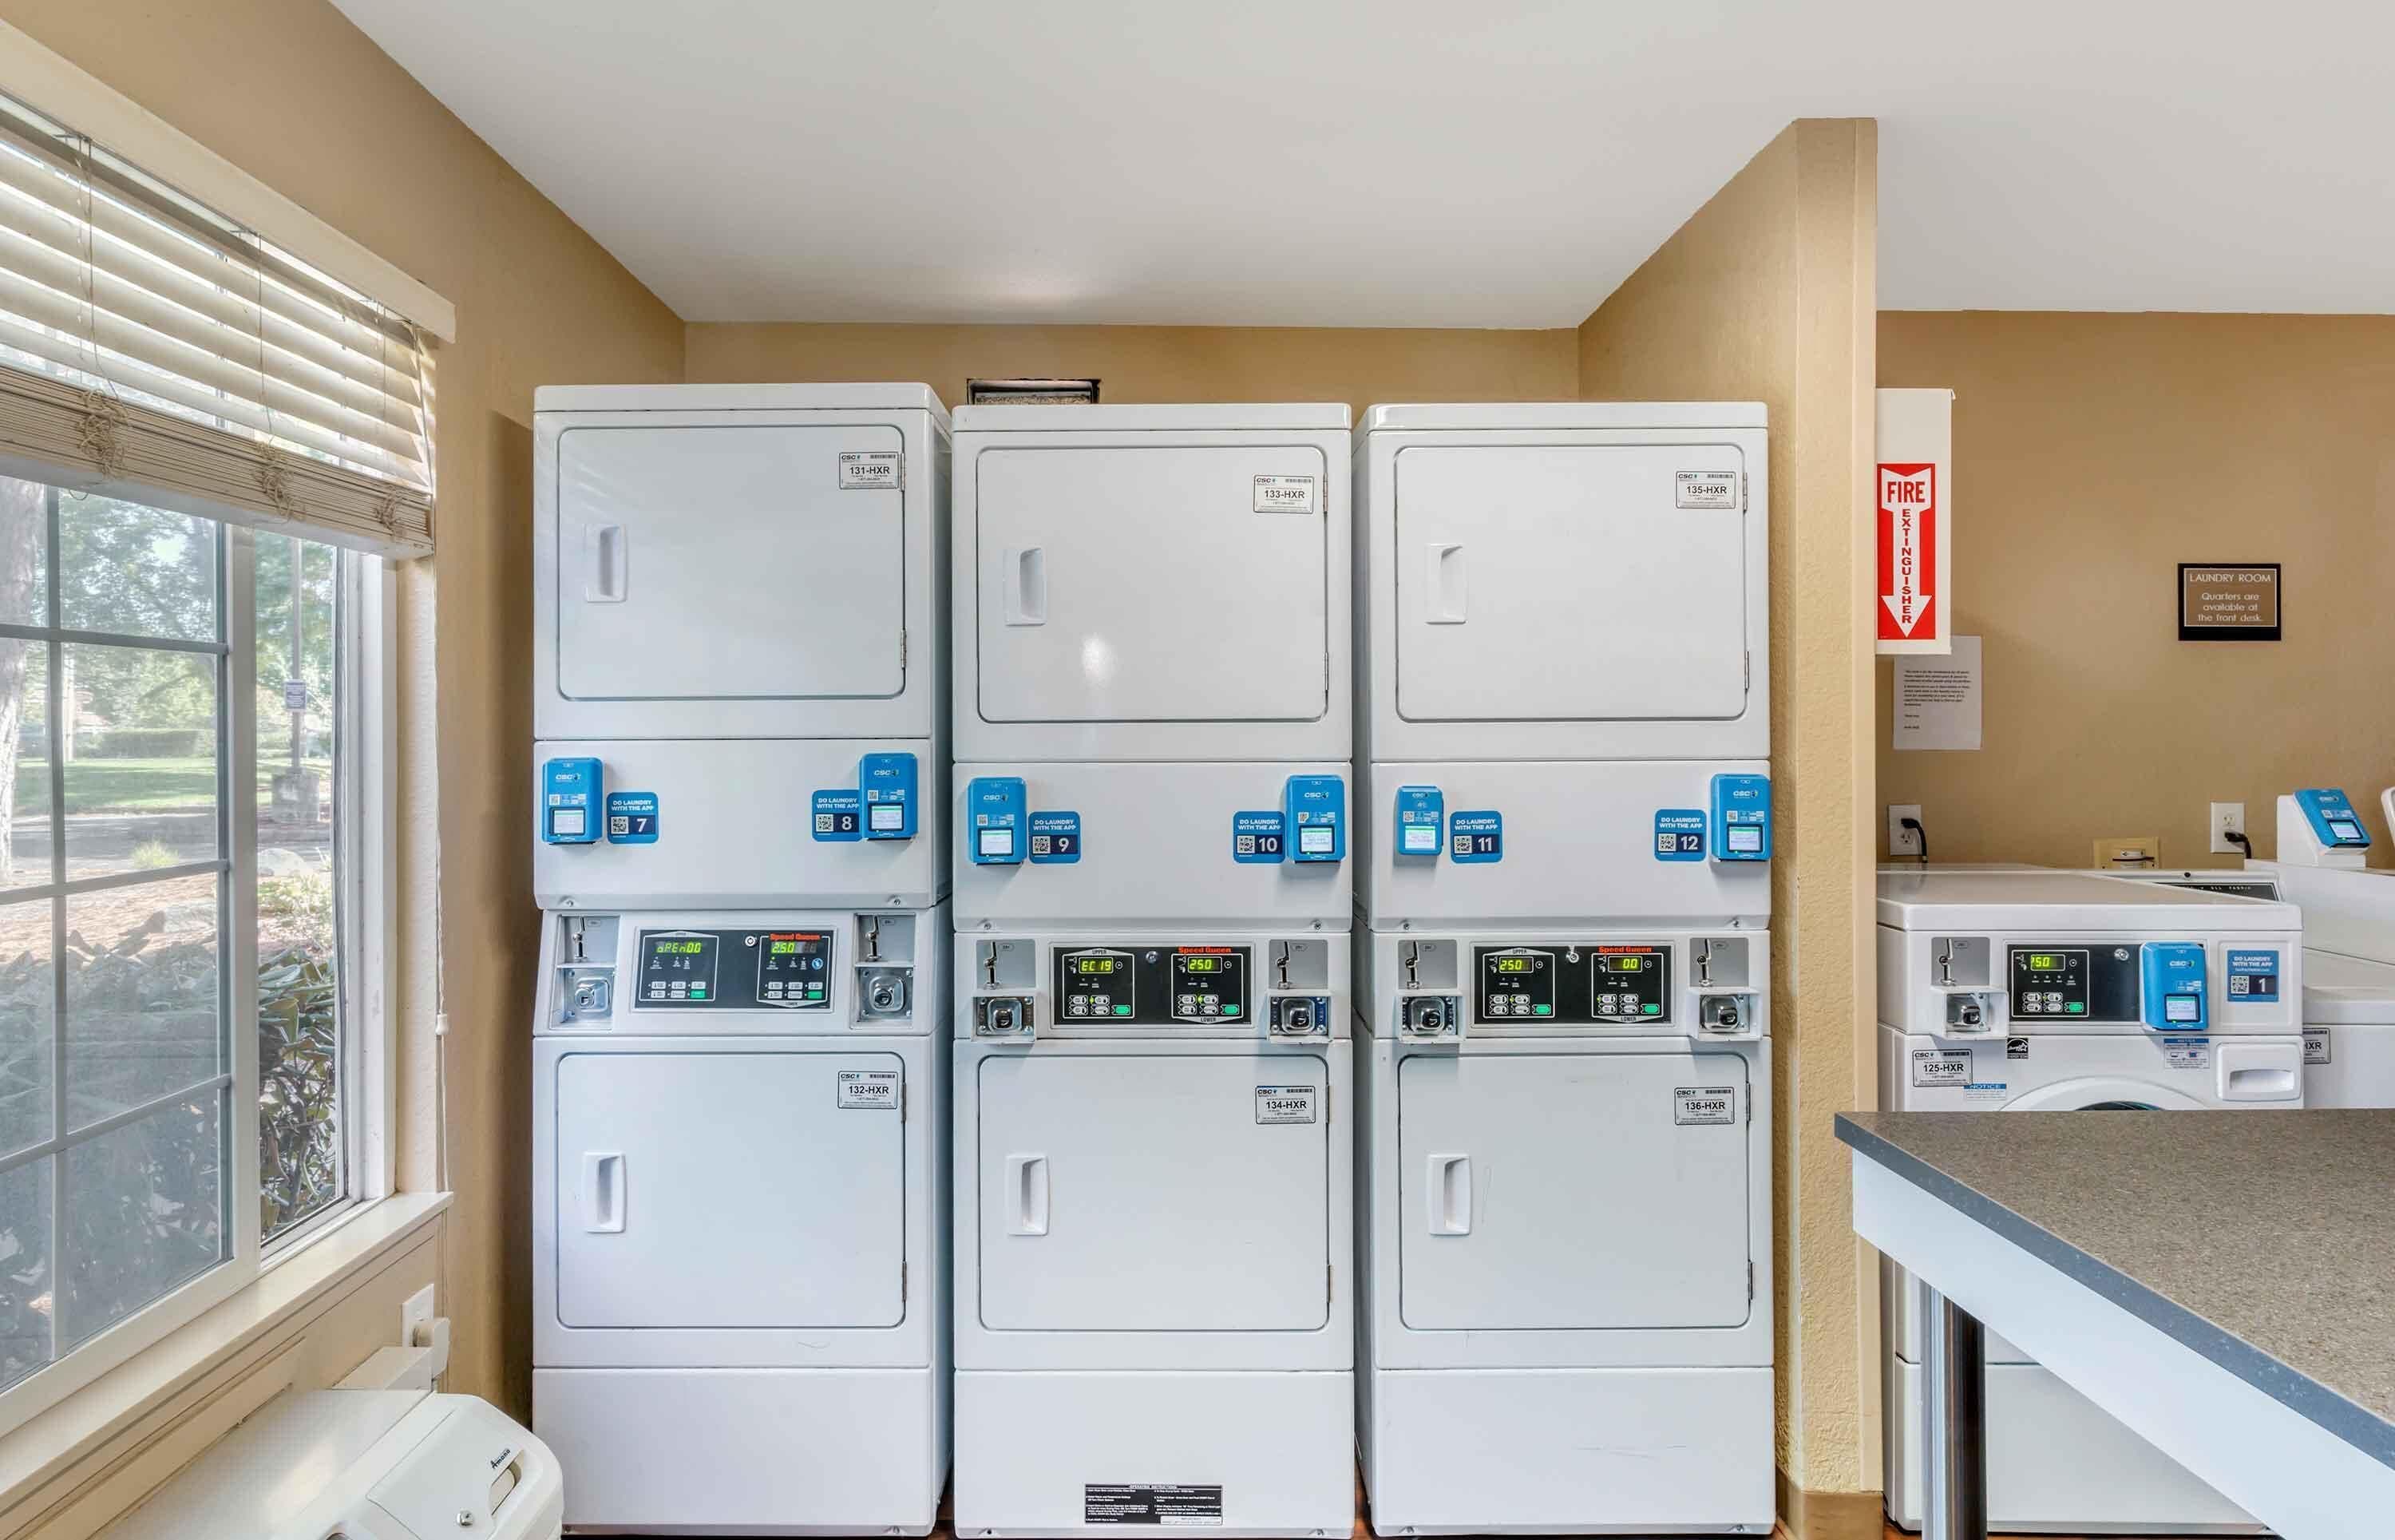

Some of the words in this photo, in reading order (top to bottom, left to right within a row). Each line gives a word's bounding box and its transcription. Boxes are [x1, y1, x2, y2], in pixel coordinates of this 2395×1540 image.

[1887, 481, 1926, 503] FIRE
[1902, 509, 1912, 624] EXTINGUISHER
[636, 818, 647, 832] 7
[841, 816, 852, 829] 8
[1059, 838, 1069, 852] 9
[1259, 837, 1277, 852] 10
[1479, 837, 1492, 852] 11
[1680, 836, 1698, 850] 12
[2258, 978, 2266, 992] 1
[1923, 1063, 1964, 1072] 125-HXR
[1685, 1102, 1725, 1110] 136-HXR
